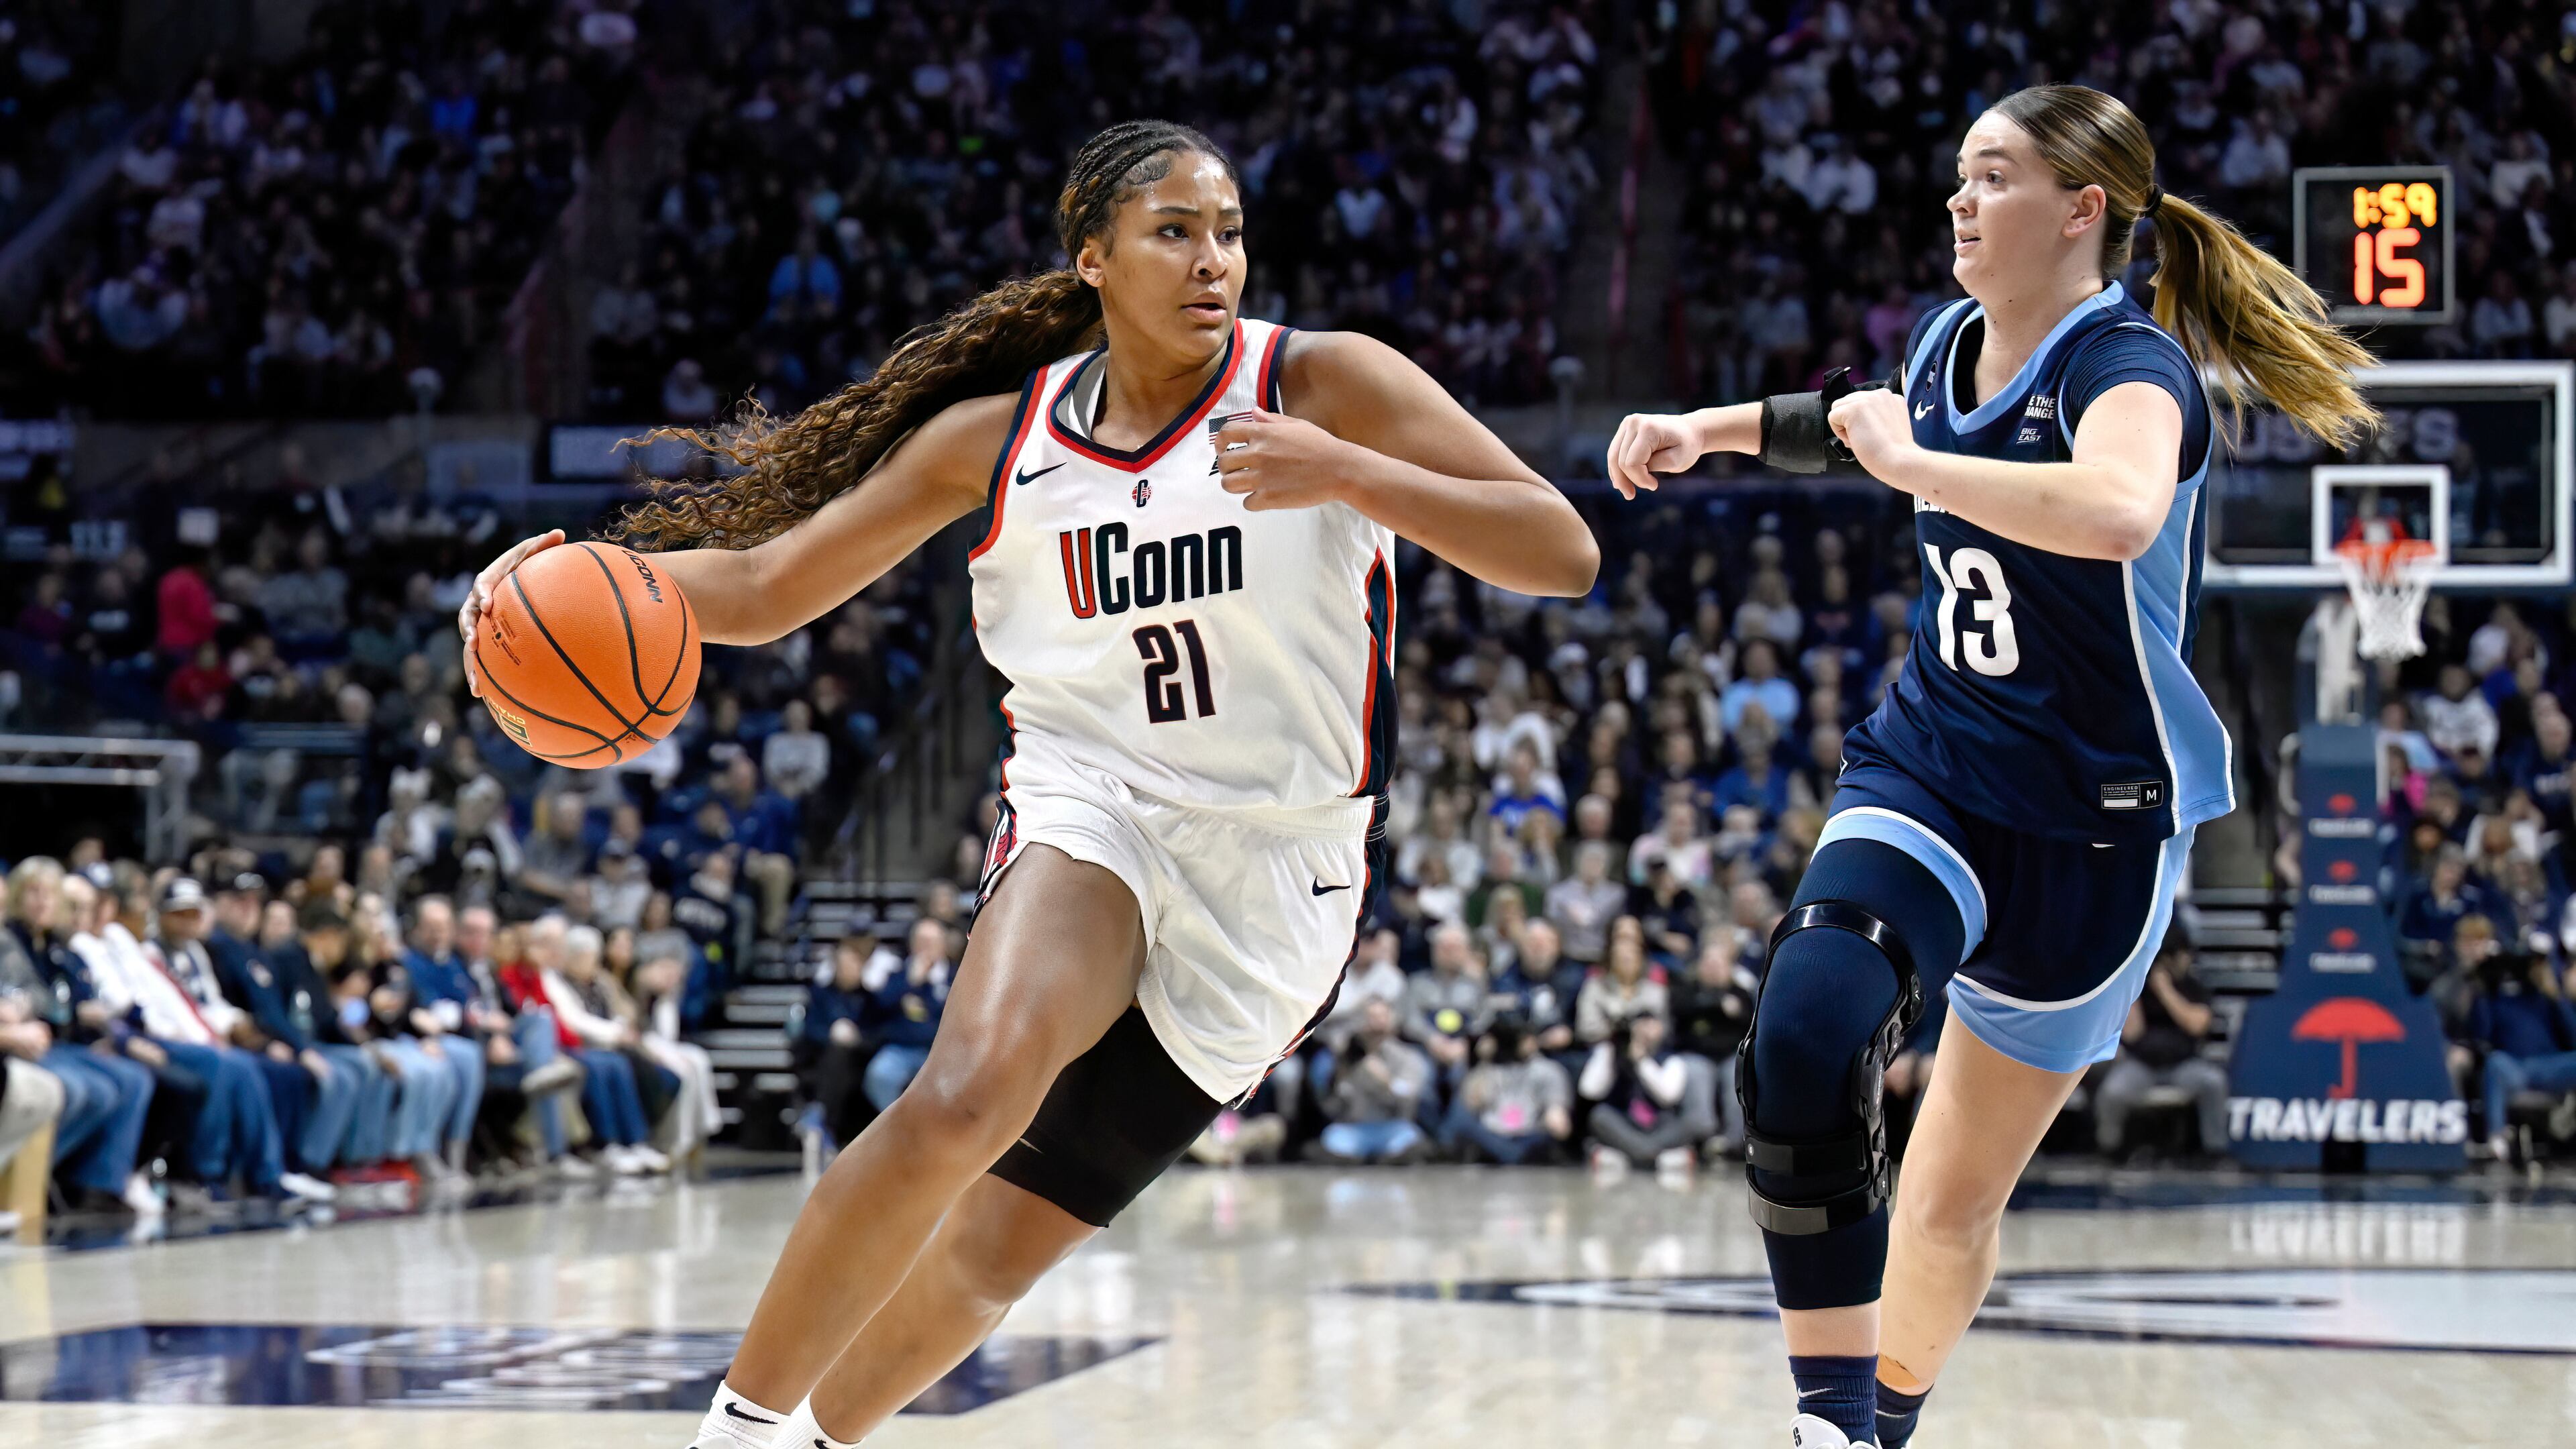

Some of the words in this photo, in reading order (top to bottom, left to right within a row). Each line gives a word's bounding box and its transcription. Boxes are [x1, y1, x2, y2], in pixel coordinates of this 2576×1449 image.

[2353, 182, 2437, 229] 1:59
[2353, 227, 2426, 307] 15
[2024, 406, 2054, 419] HANGE
[2028, 395, 2035, 407] E
[2036, 396, 2055, 408] THE
[621, 549, 663, 603] UCONN
[1059, 521, 1243, 619] UConn
[1923, 542, 2019, 677] 13
[1132, 619, 1216, 724] 21
[2146, 789, 2157, 802] M
[2226, 1096, 2467, 1144] TRAVELERS
